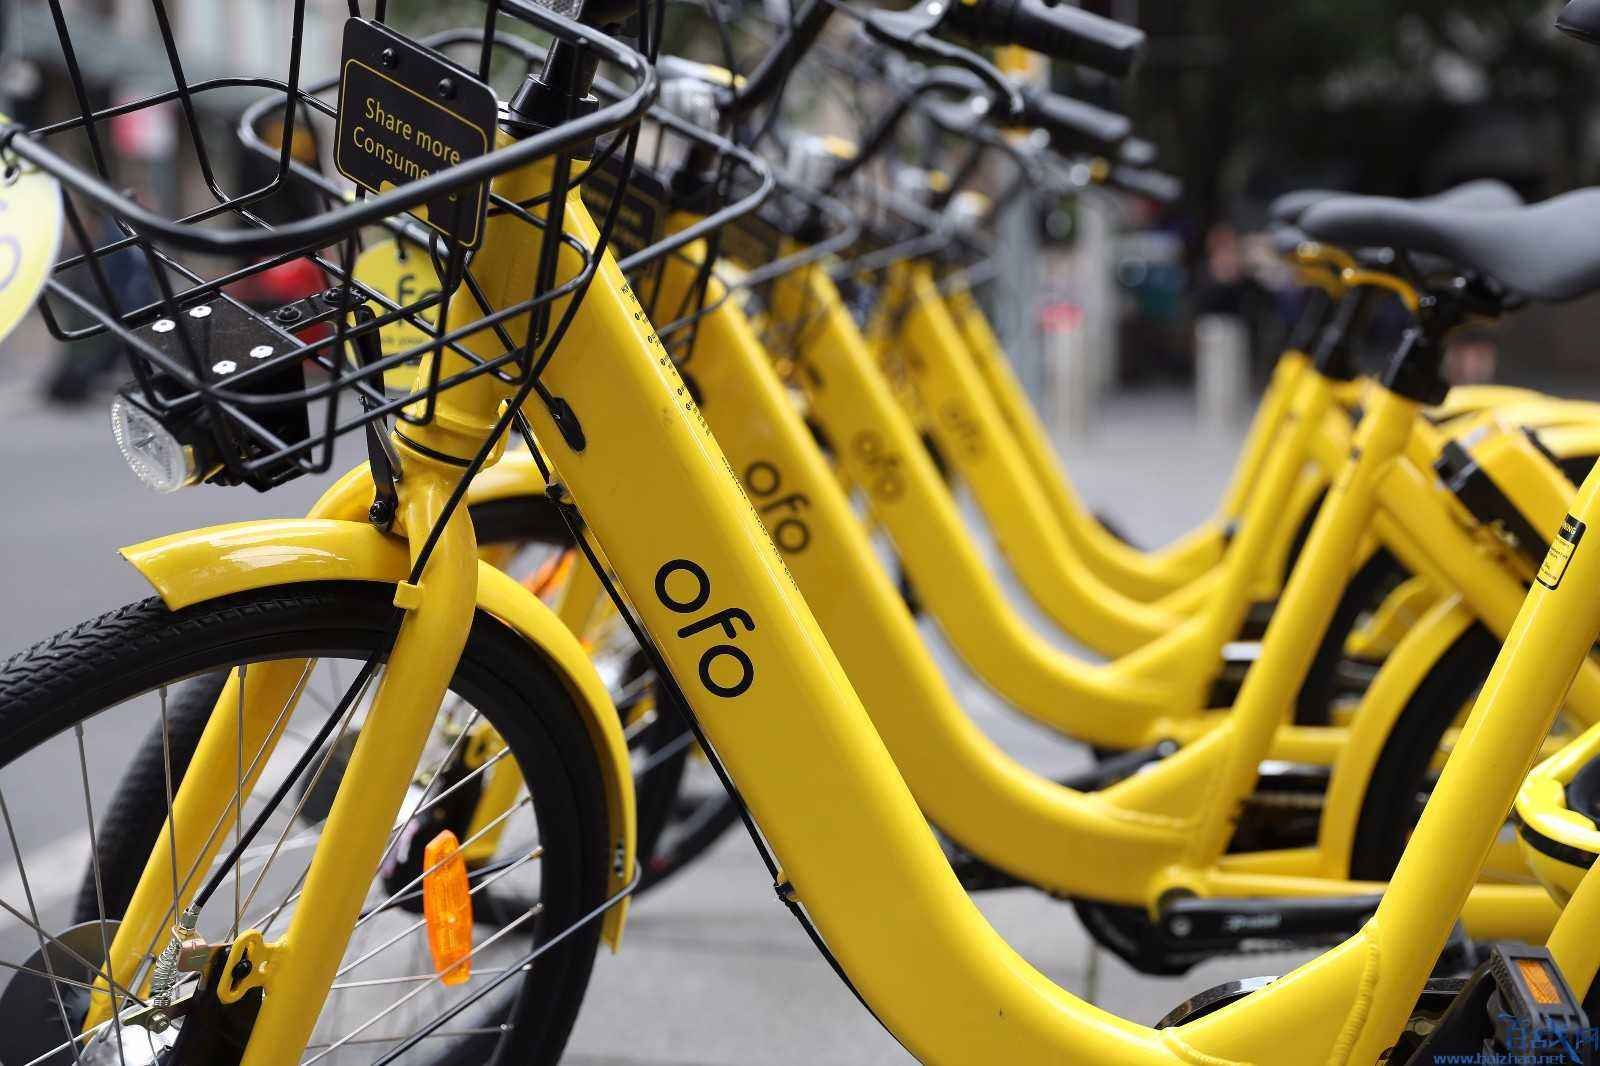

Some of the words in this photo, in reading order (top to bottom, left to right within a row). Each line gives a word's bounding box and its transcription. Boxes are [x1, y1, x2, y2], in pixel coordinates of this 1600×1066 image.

[364, 97, 413, 141] Share
[415, 129, 461, 167] more
[745, 461, 809, 553] ofo
[655, 559, 755, 698] ofo
